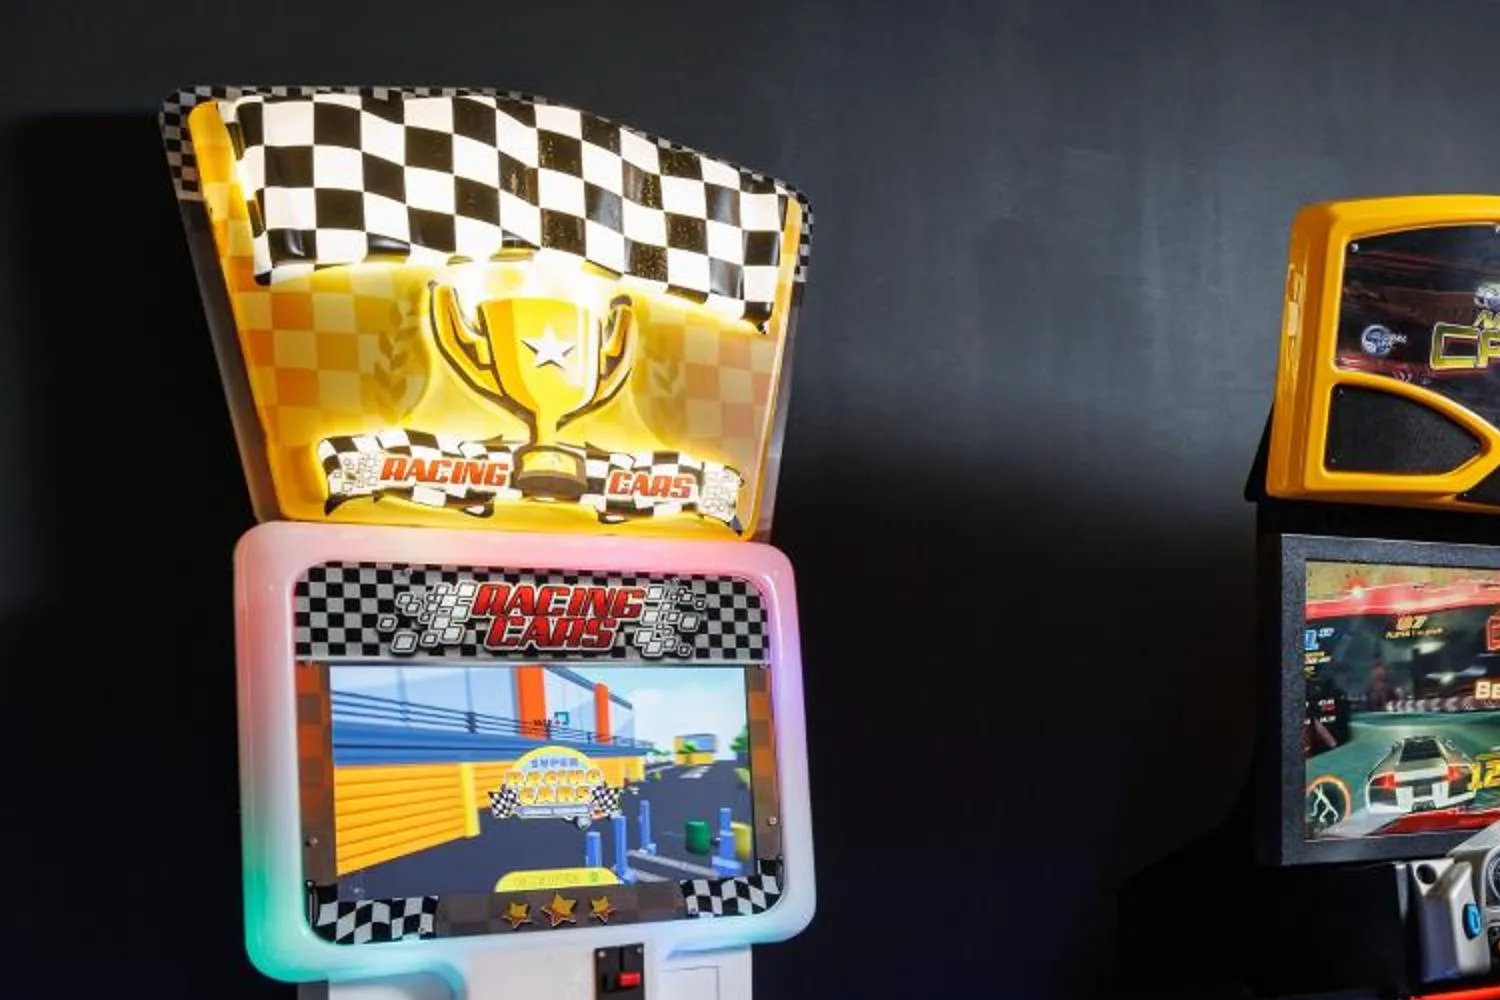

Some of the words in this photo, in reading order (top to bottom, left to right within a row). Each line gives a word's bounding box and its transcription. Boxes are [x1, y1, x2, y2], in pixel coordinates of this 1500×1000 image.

[380, 454, 510, 487] RACING
[608, 469, 696, 499] CARS
[471, 583, 647, 618] RACING
[486, 617, 618, 648] CARS
[506, 768, 603, 786] RACING
[519, 785, 593, 805] CARS
